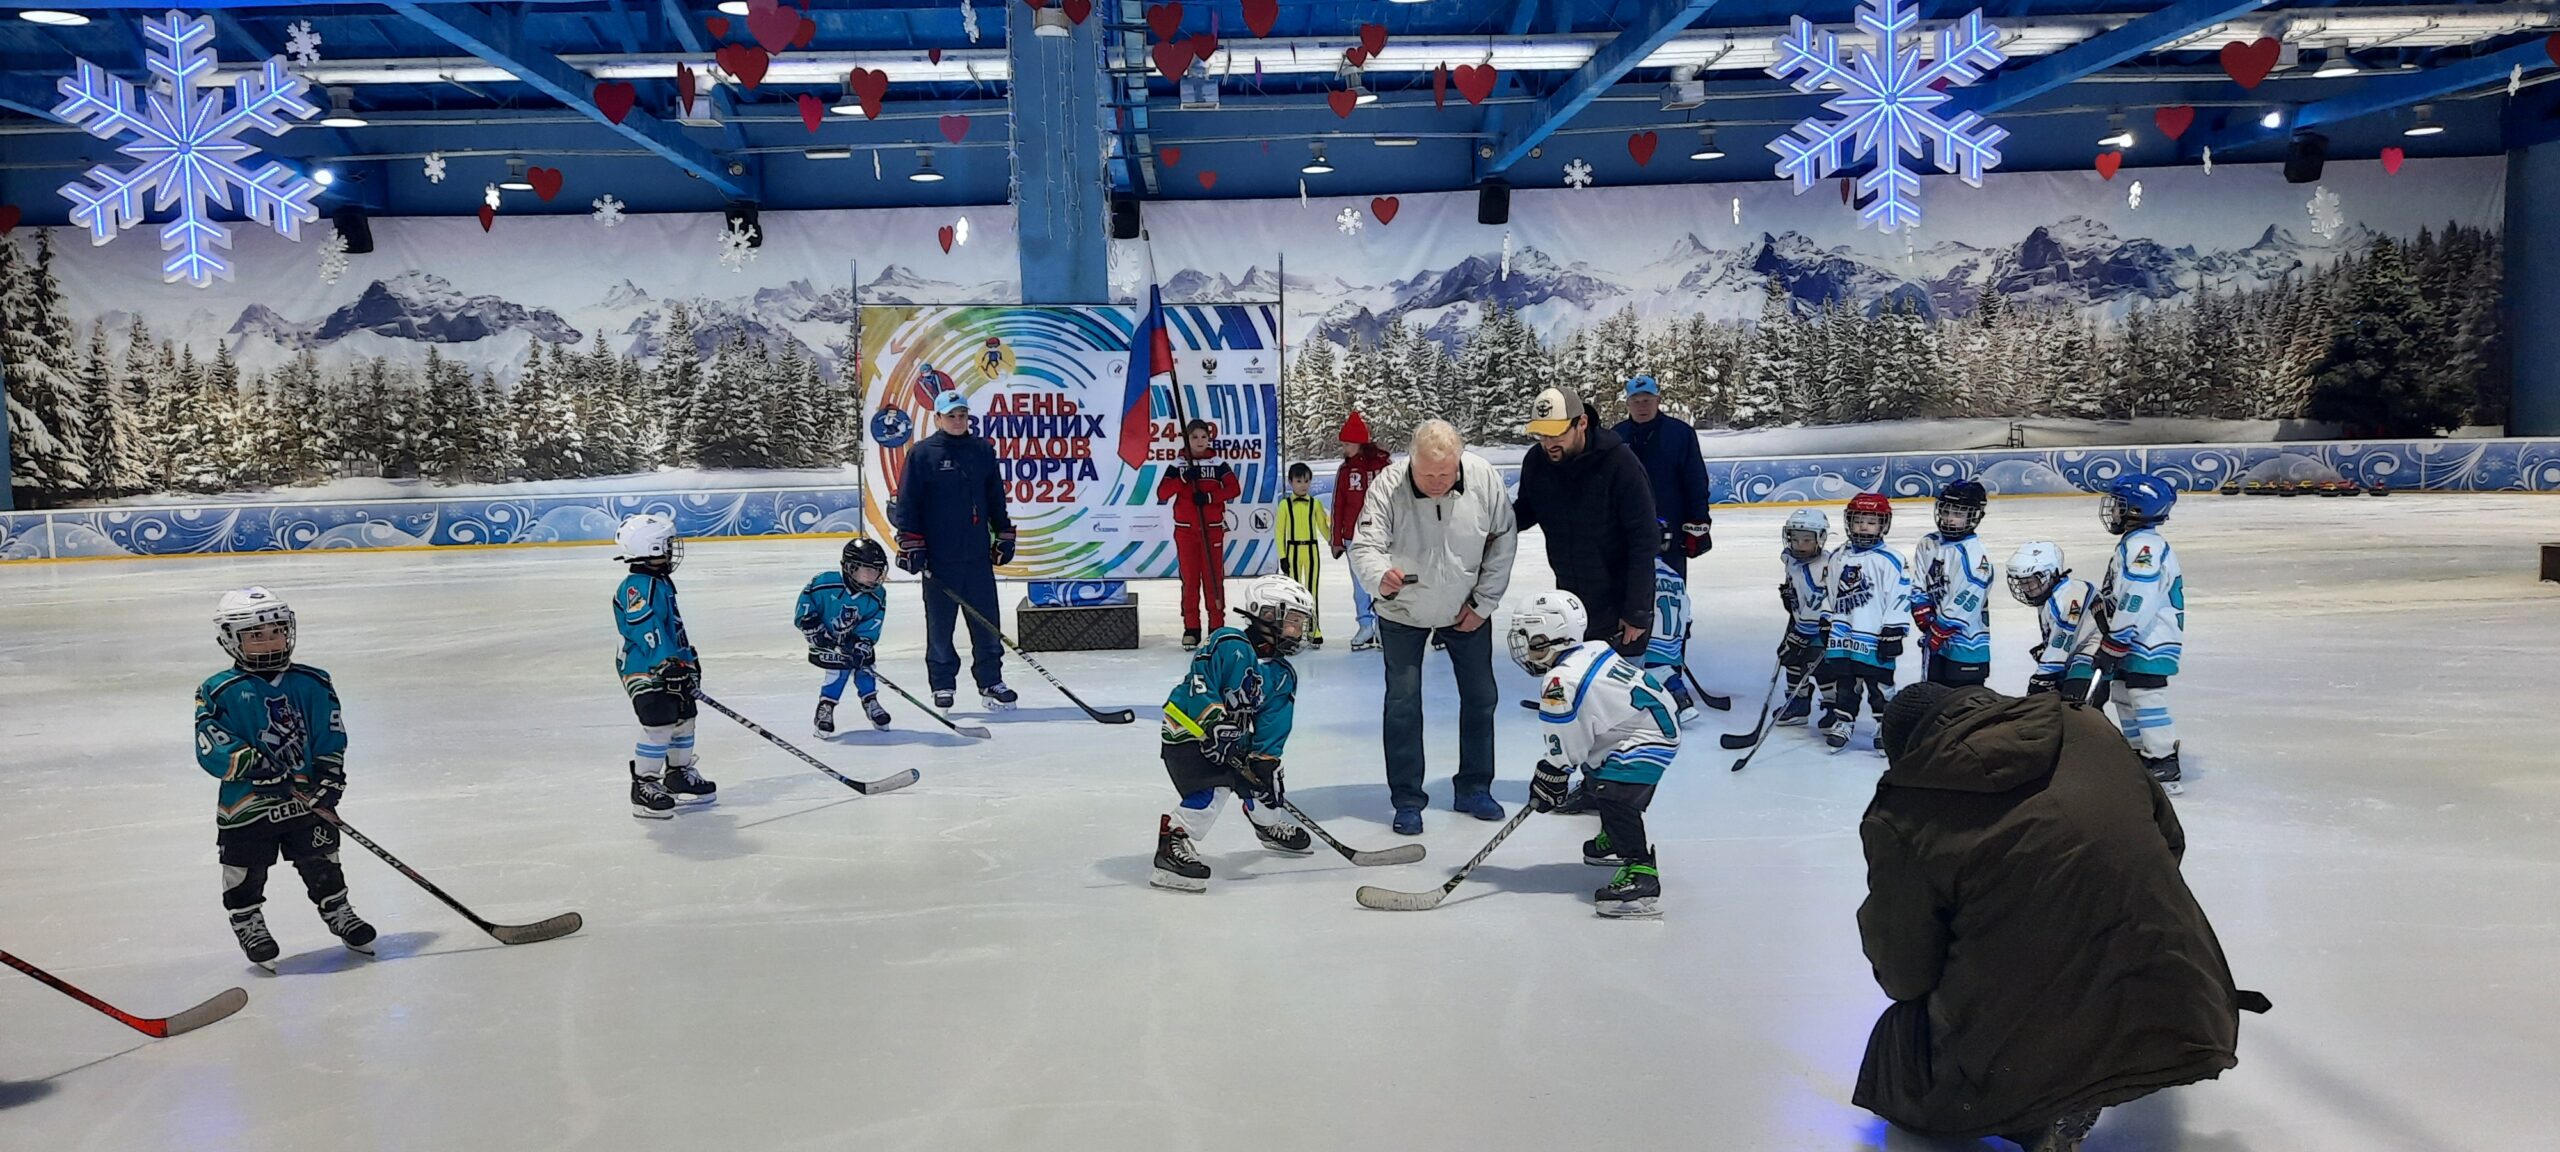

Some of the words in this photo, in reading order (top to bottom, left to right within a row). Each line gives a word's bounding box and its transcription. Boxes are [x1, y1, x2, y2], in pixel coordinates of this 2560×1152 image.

[987, 393, 1078, 417] ДЕНЬ
[967, 414, 1106, 439] ЗИМНИХ
[1208, 438, 1262, 450] ВРАЛЯ
[995, 457, 1099, 481] ПОРТА
[1656, 595, 1682, 637] 17
[269, 802, 310, 821] СЕВА
